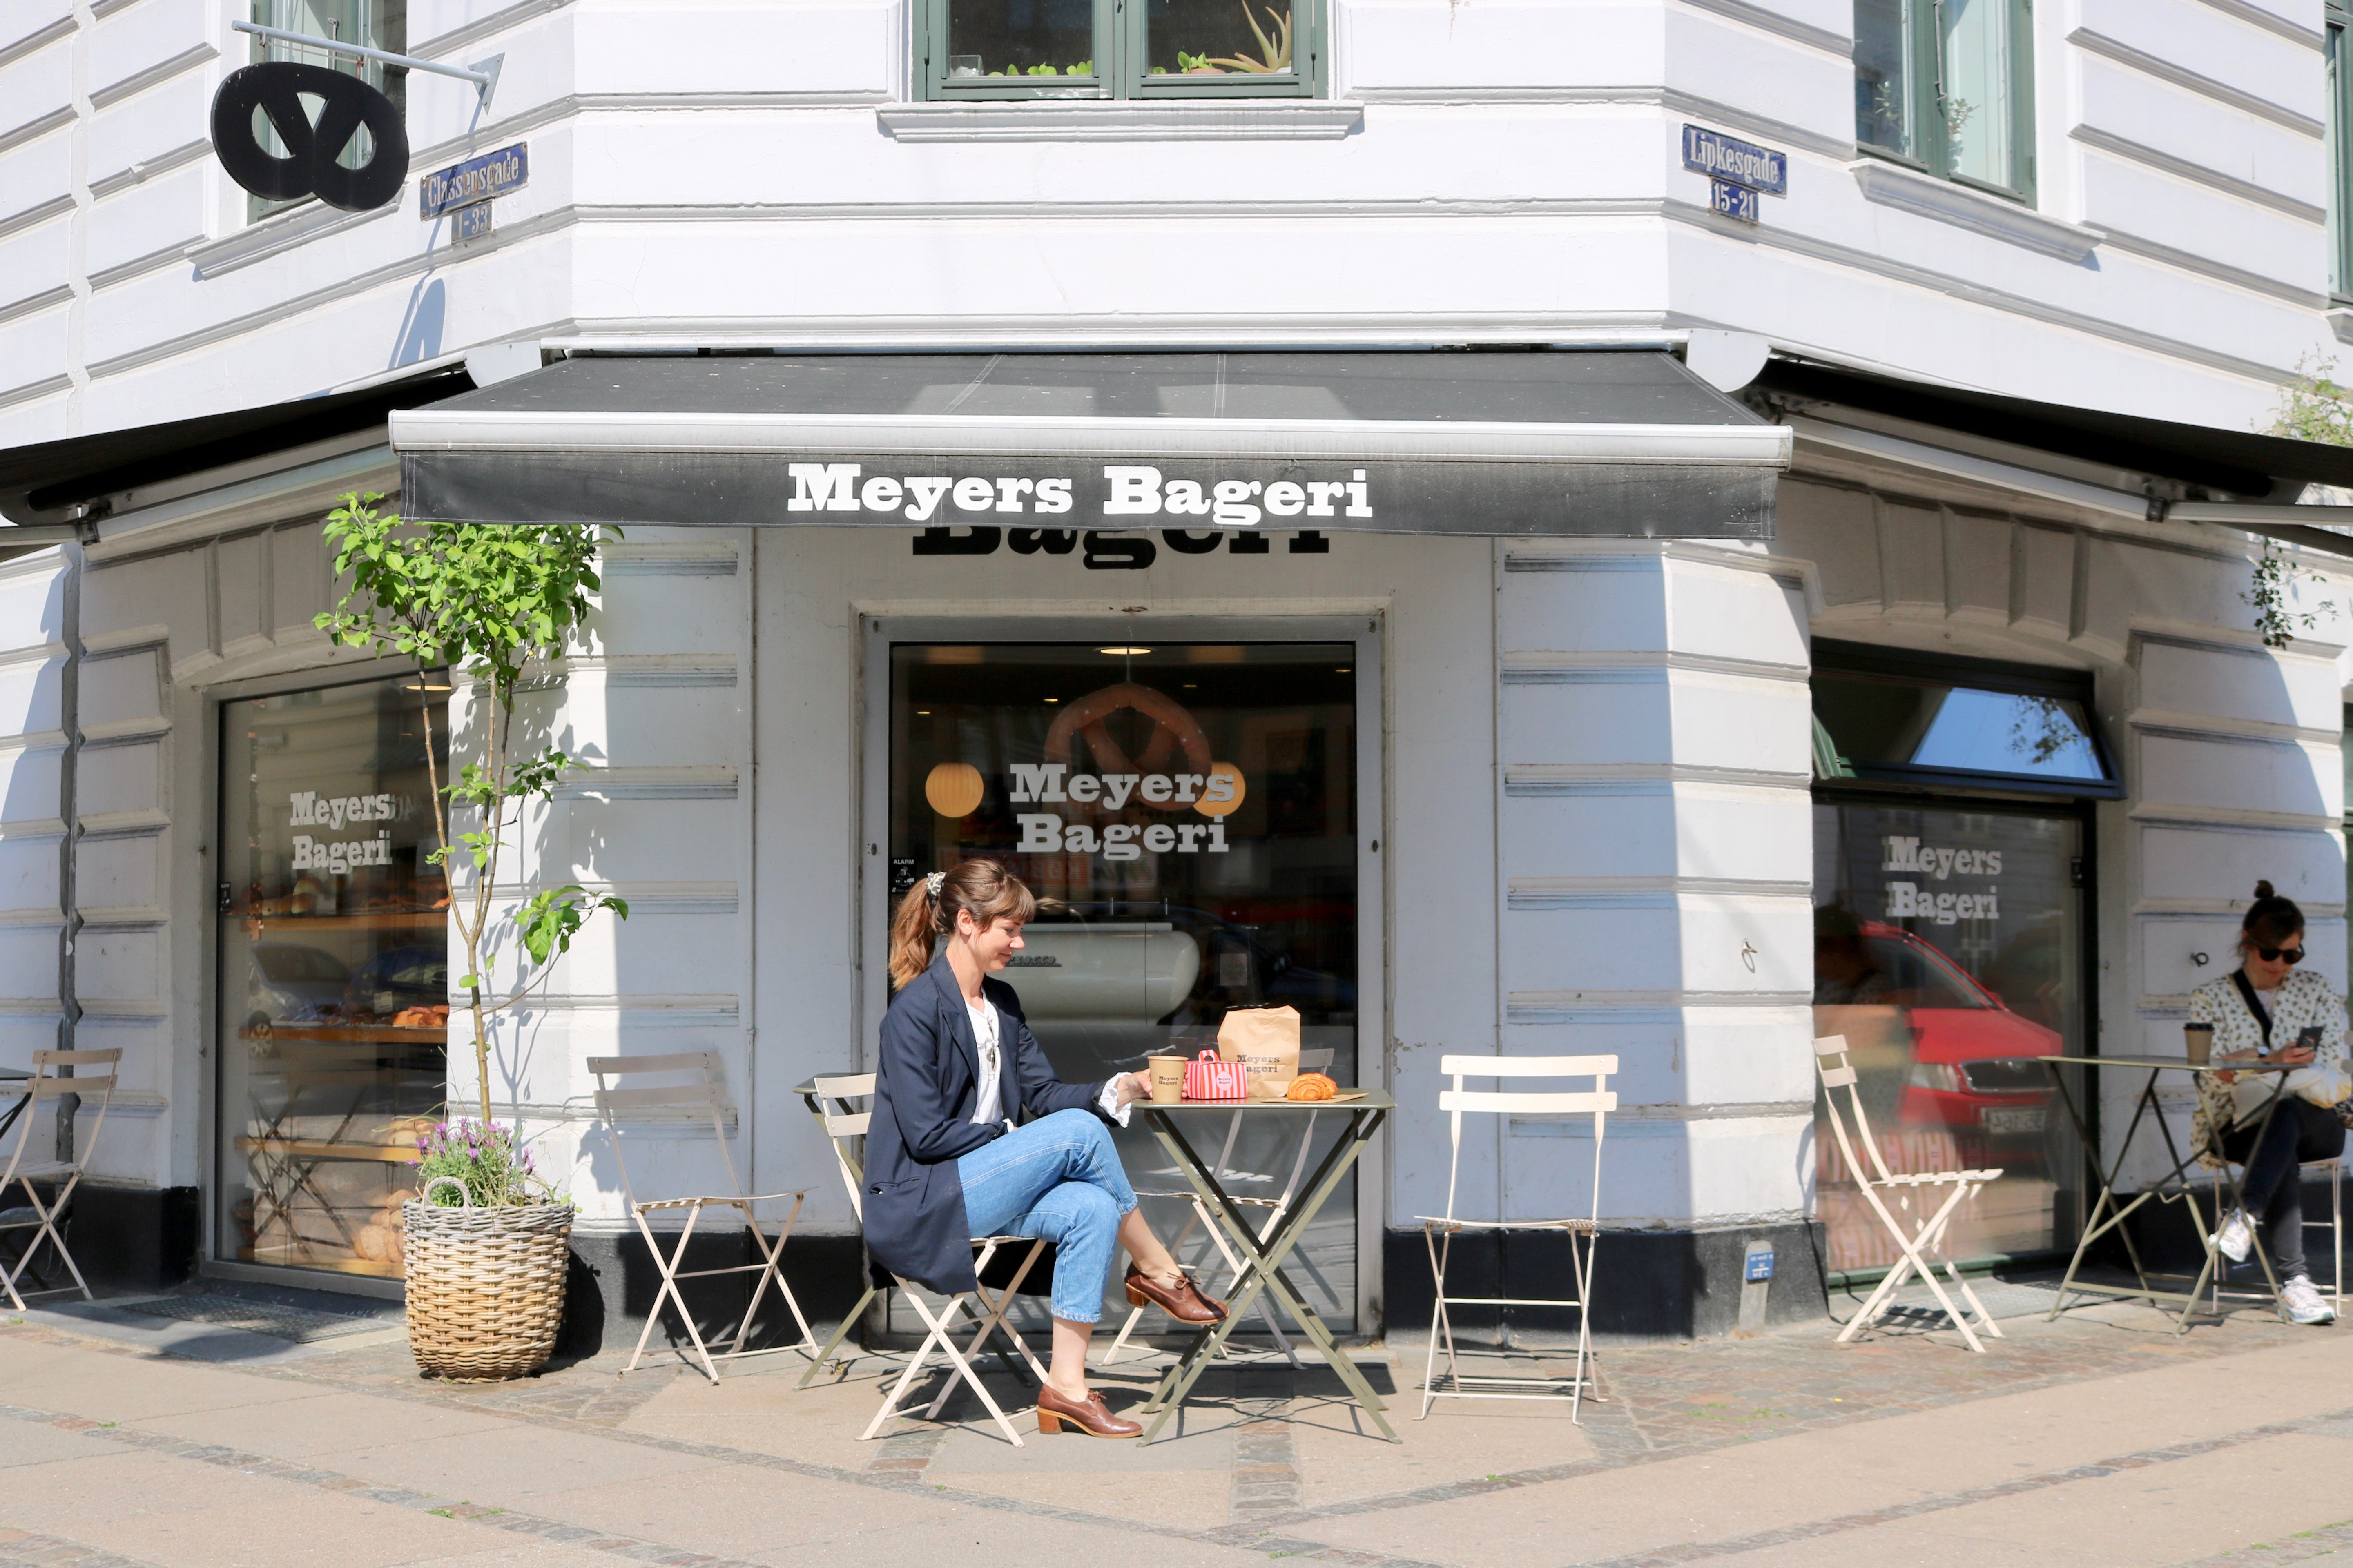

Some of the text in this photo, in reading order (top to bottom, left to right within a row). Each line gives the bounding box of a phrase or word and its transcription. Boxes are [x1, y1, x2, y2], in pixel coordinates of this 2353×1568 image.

[428, 151, 519, 207] Classensgade
[1690, 130, 1778, 183] Lipkesgade
[457, 205, 488, 238] 1-33
[1714, 183, 1756, 220] 15-21
[787, 463, 1372, 526] Meyers Bageri
[1010, 764, 1235, 810] Meyers
[290, 791, 390, 830] Meyers
[292, 829, 388, 874] Bageri
[1017, 814, 1229, 860] Bageri
[1888, 835, 2002, 880] Meyers
[1891, 881, 1999, 925] Bageri
[1237, 1054, 1280, 1064] Meyers
[1246, 1065, 1278, 1074] ageri
